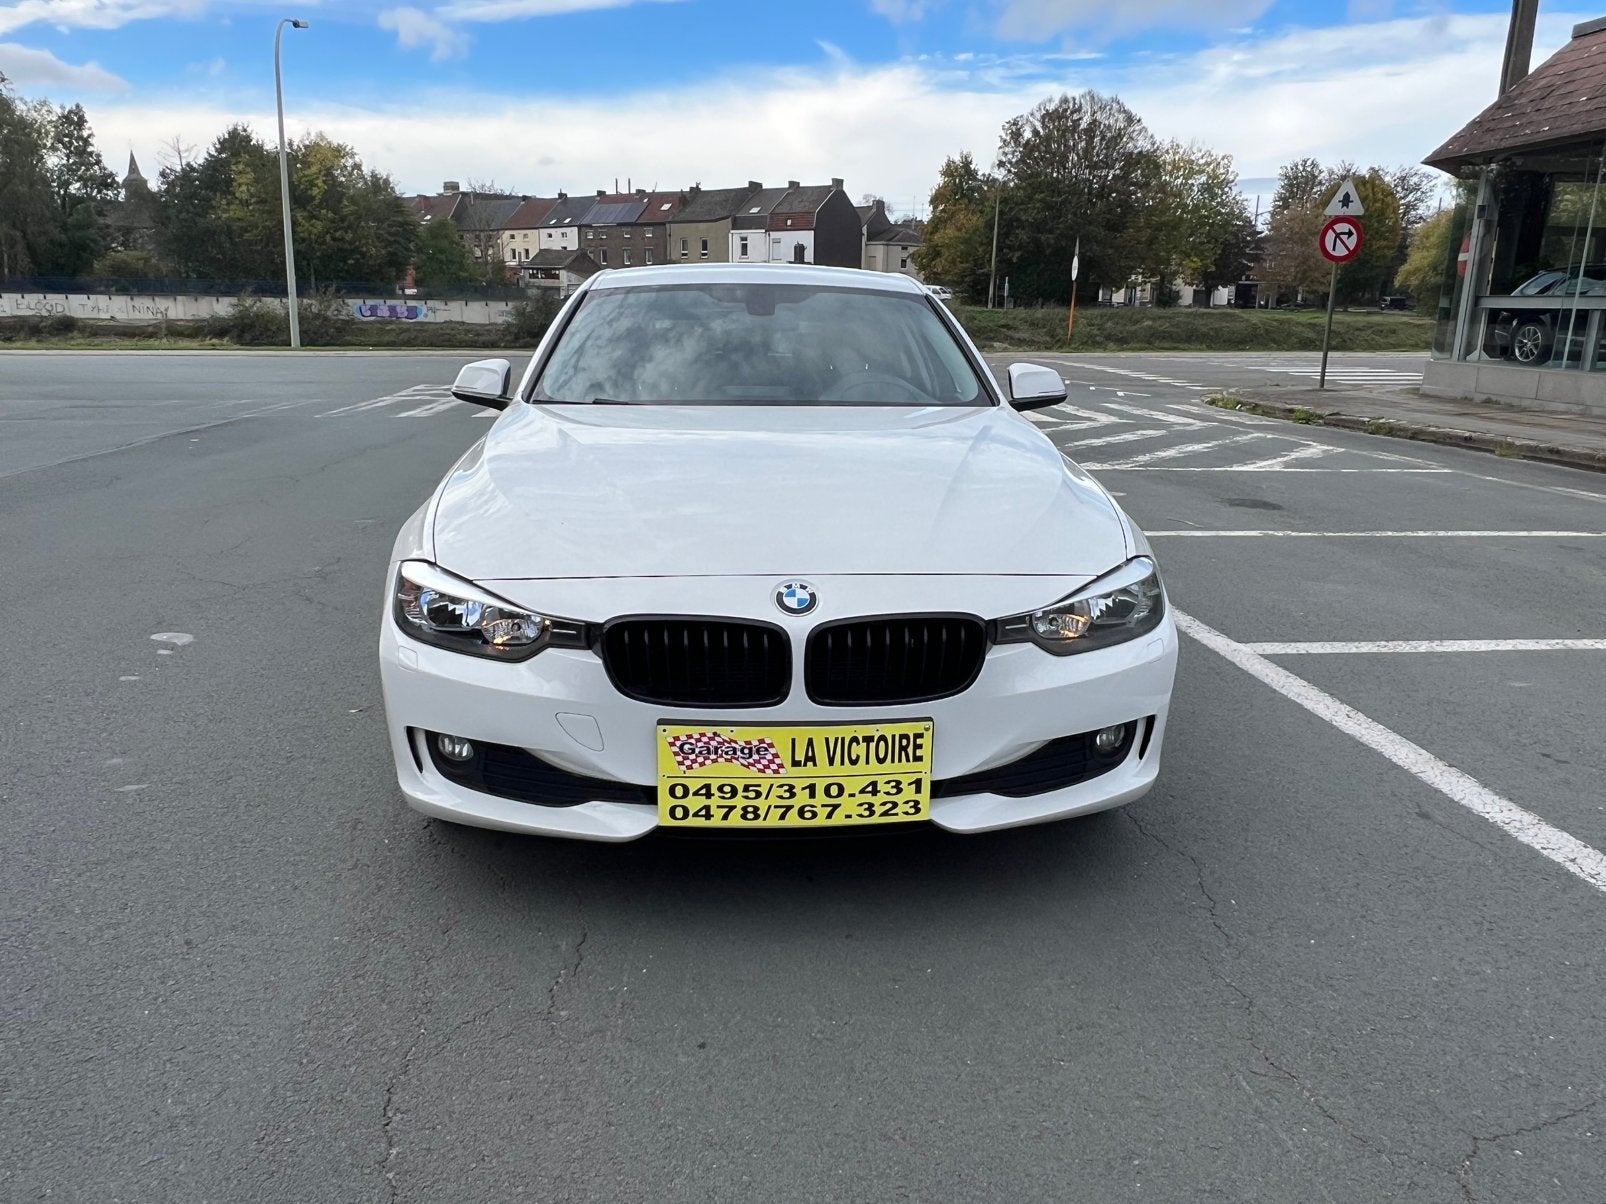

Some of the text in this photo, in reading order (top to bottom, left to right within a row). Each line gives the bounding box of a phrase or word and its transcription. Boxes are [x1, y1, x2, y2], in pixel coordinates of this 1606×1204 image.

[679, 732, 925, 768] Garage LA VICTOIRE
[668, 777, 923, 801] 0495/310.431
[668, 800, 922, 821] 0478/767.323
